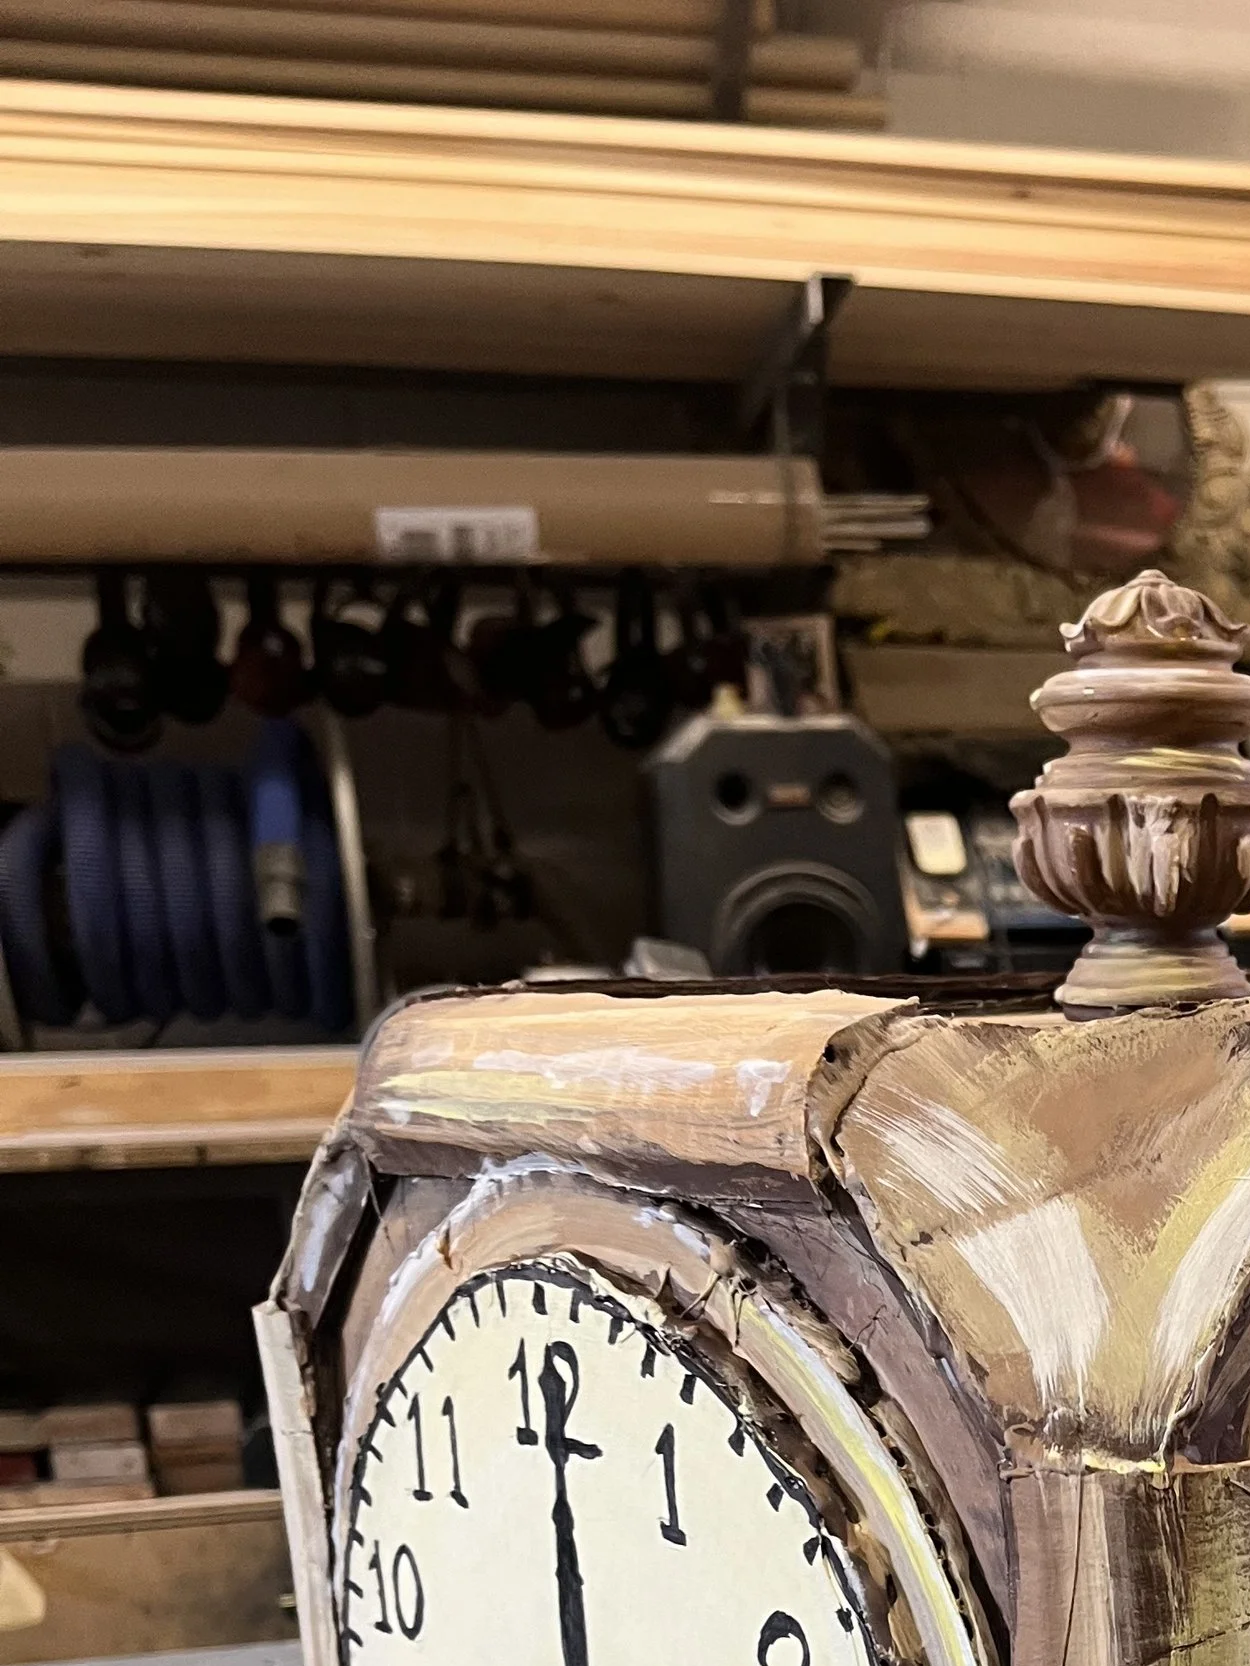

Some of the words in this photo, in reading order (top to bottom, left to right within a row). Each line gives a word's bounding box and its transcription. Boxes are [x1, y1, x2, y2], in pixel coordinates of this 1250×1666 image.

[408, 1394, 468, 1508] 11
[509, 1339, 602, 1458] 12
[655, 1424, 686, 1546] 1
[369, 1541, 423, 1640] 10
